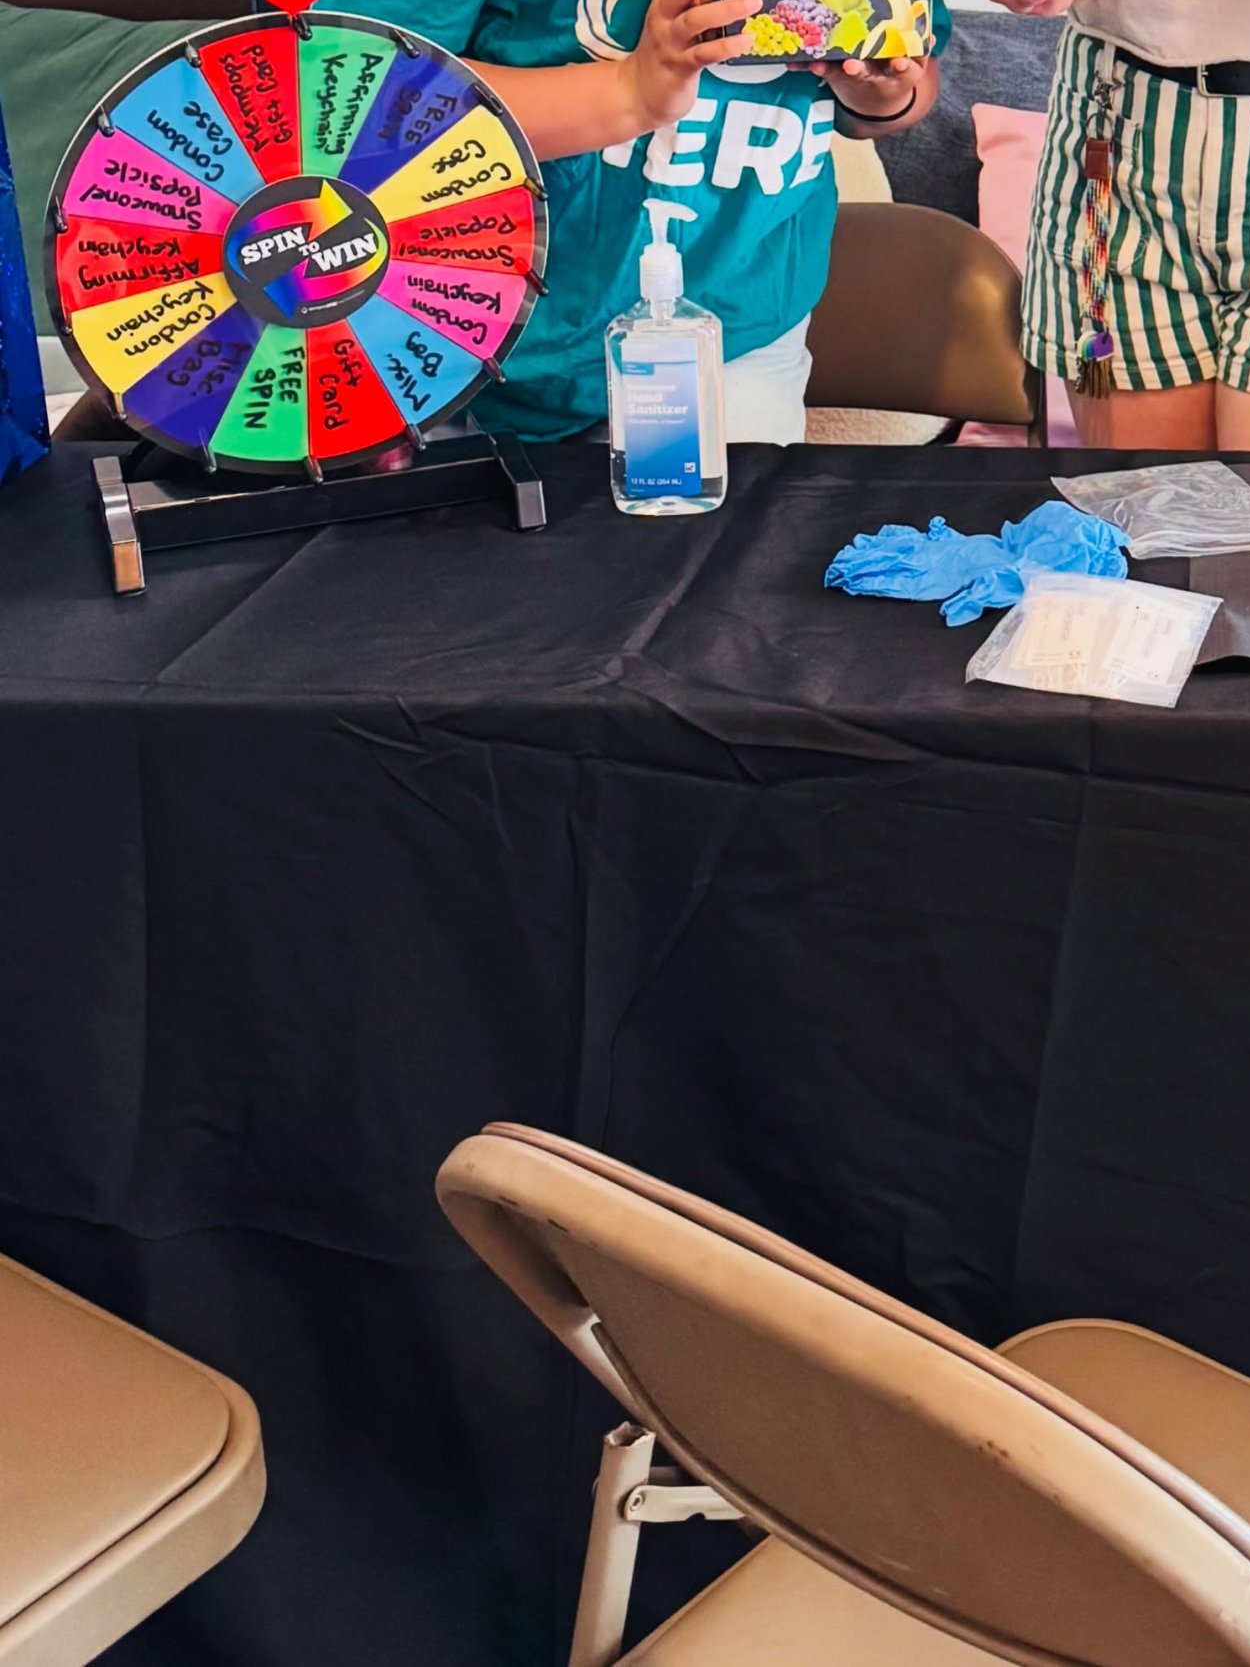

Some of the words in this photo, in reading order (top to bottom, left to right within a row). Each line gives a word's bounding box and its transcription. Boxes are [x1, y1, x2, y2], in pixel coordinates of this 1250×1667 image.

[240, 44, 279, 93] Card
[265, 99, 294, 144] Gift
[315, 53, 348, 150] Keychain
[324, 52, 384, 156] Affirming
[147, 109, 225, 183] Condom
[183, 100, 234, 156] Case
[602, 97, 835, 196] ERE
[432, 139, 487, 174] Case
[103, 158, 202, 207] Popsicle
[421, 162, 512, 203] Condom
[78, 237, 182, 260] Keychain
[240, 226, 306, 265] SPIN
[298, 241, 321, 257] TO
[421, 213, 518, 241] Popsicle
[78, 257, 200, 291] Affirming
[311, 233, 379, 272] WIN
[106, 280, 214, 342] Keychain
[407, 274, 501, 314] Keychain
[124, 303, 217, 357] Condom
[411, 297, 488, 345] Condom
[167, 339, 222, 387] Bag
[277, 345, 306, 404] FREE
[333, 339, 362, 387] Gift
[405, 331, 444, 378] Bag
[243, 367, 277, 429] SPIN
[319, 374, 349, 430] Card
[626, 403, 689, 415] Sanitizer
